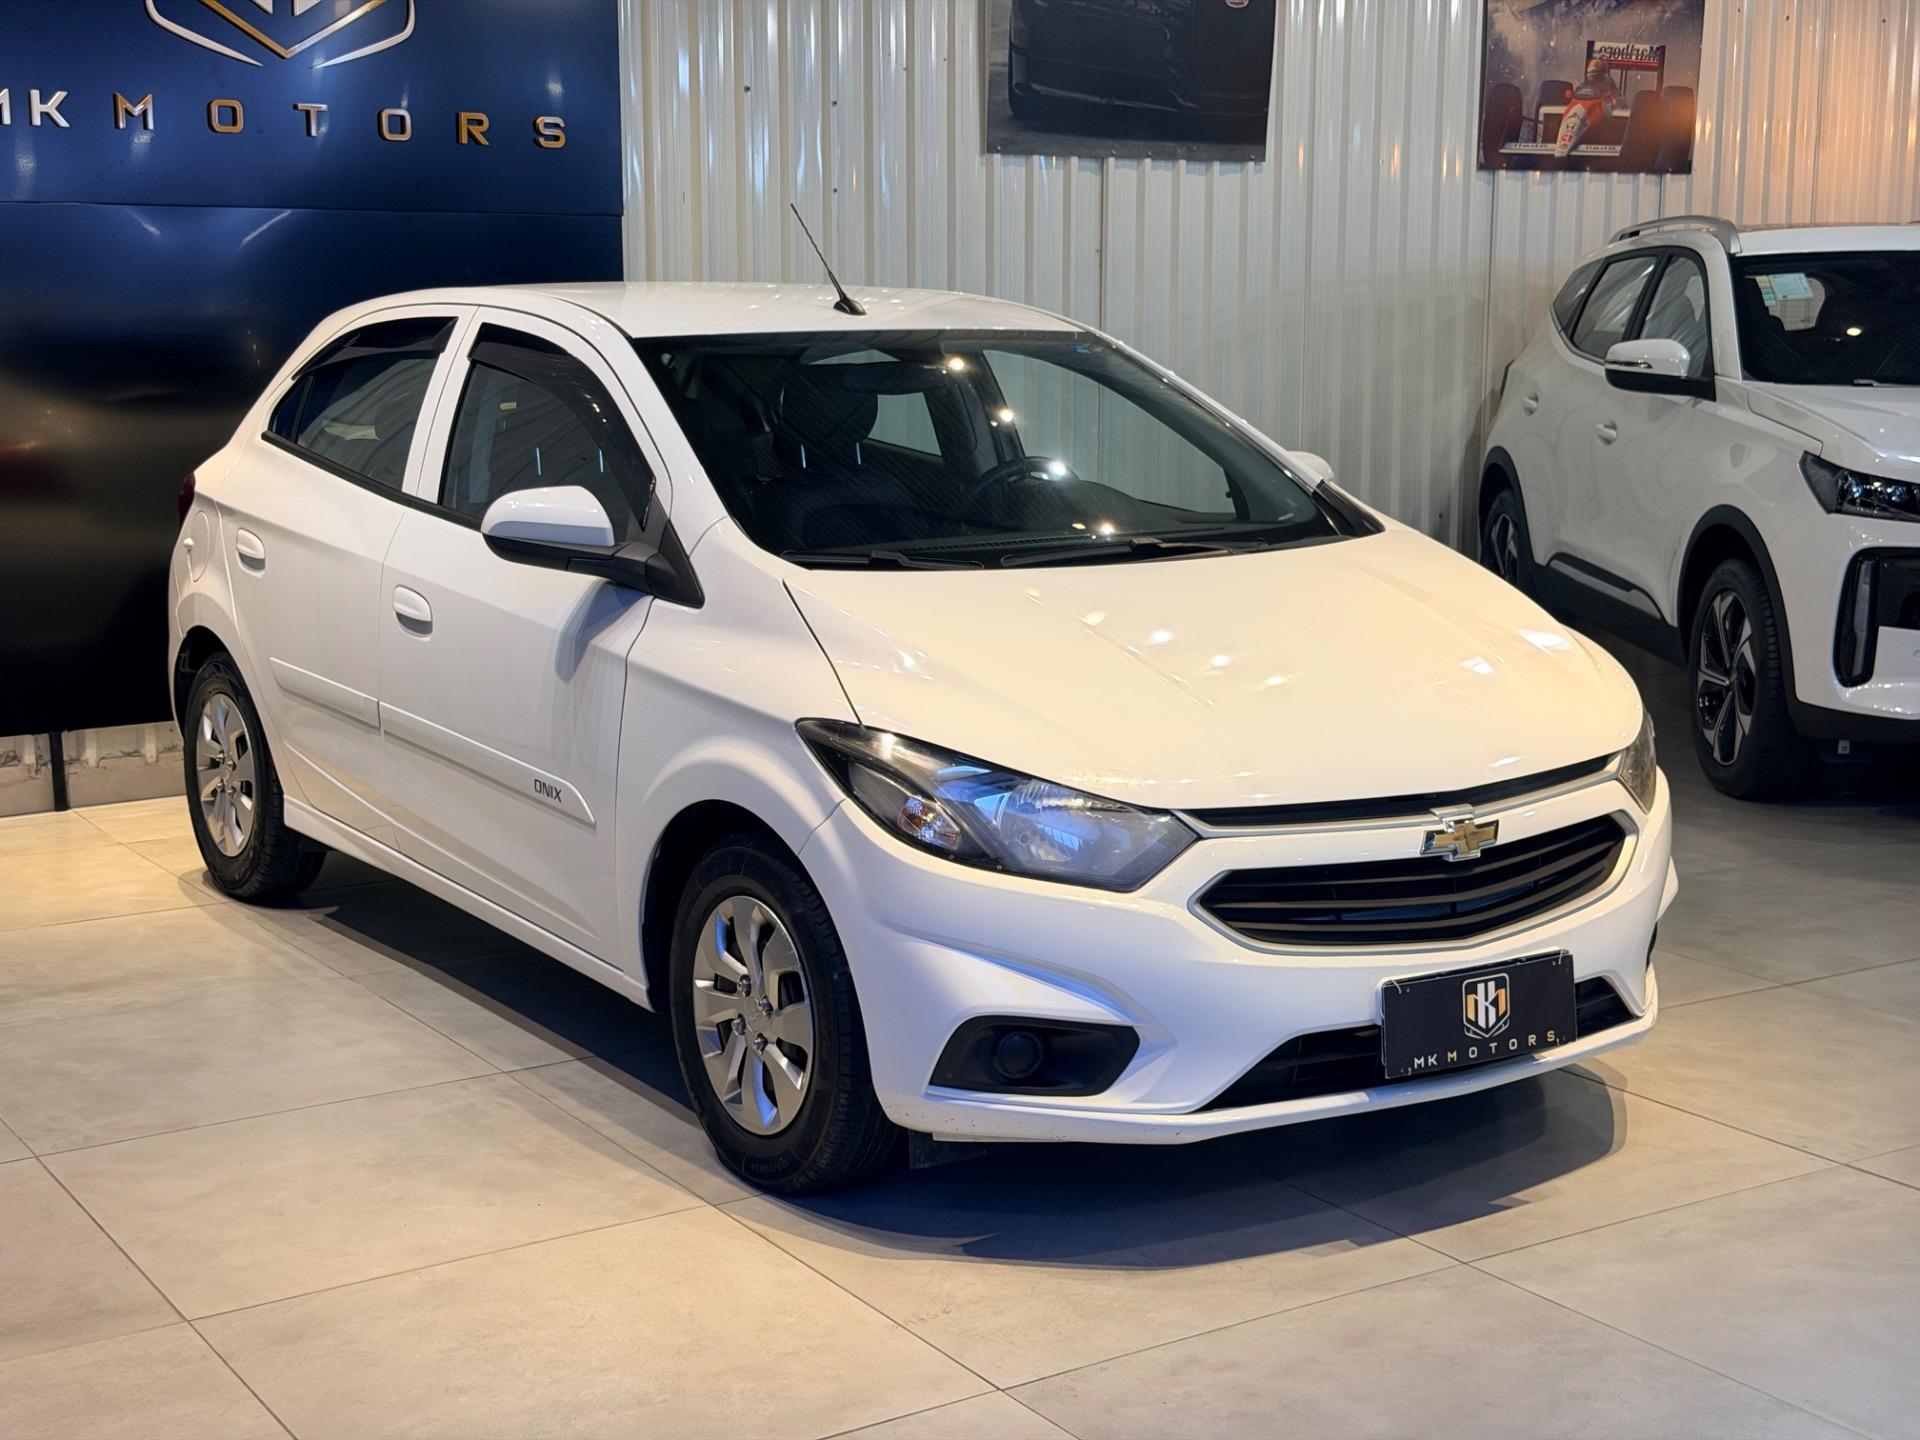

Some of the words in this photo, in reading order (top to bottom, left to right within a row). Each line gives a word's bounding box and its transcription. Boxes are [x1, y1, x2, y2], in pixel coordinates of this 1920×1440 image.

[113, 92, 567, 149] MOTORS
[534, 778, 562, 803] ONIX
[1414, 1053, 1437, 1069] MK
[1447, 1030, 1556, 1063] MOTORS
